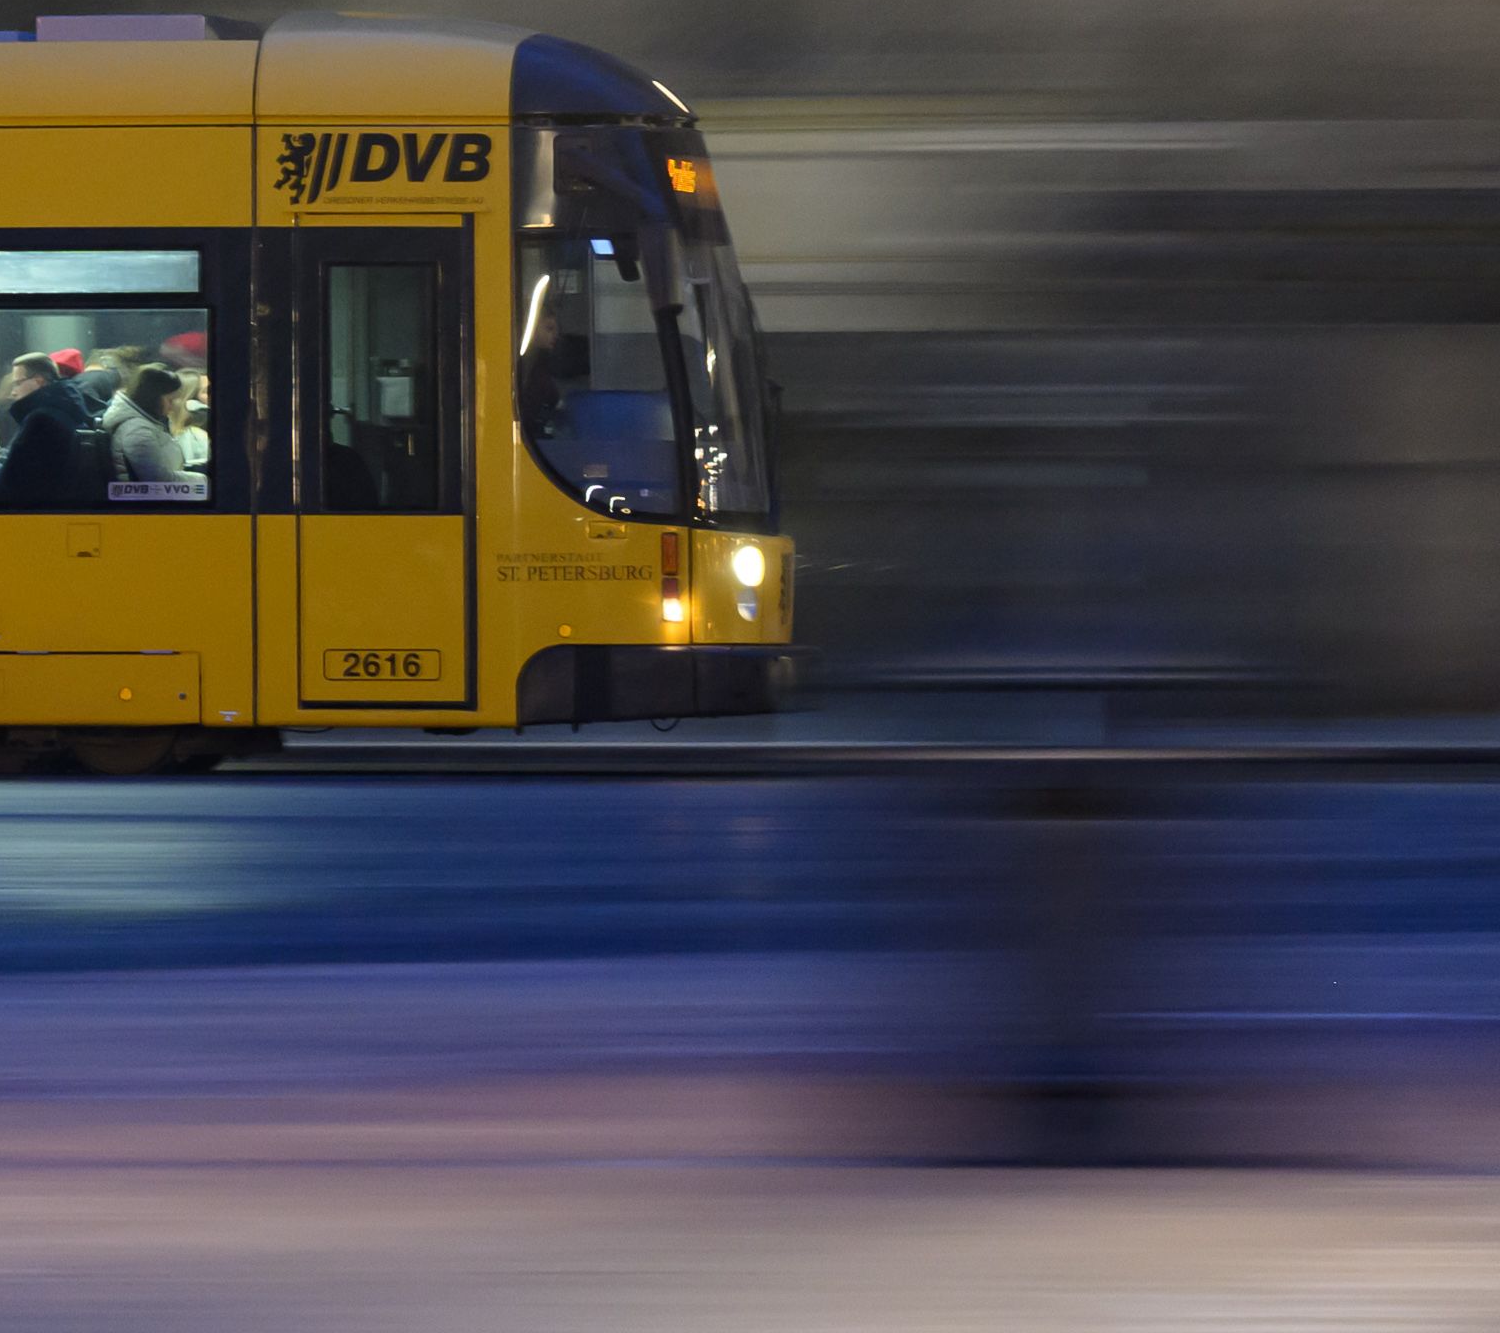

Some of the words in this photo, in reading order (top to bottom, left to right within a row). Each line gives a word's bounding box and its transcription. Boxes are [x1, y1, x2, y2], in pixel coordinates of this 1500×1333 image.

[350, 133, 492, 182] DVB
[496, 565, 520, 582] ST.
[527, 565, 653, 582] PETERSBURG
[343, 653, 421, 677] 2616
